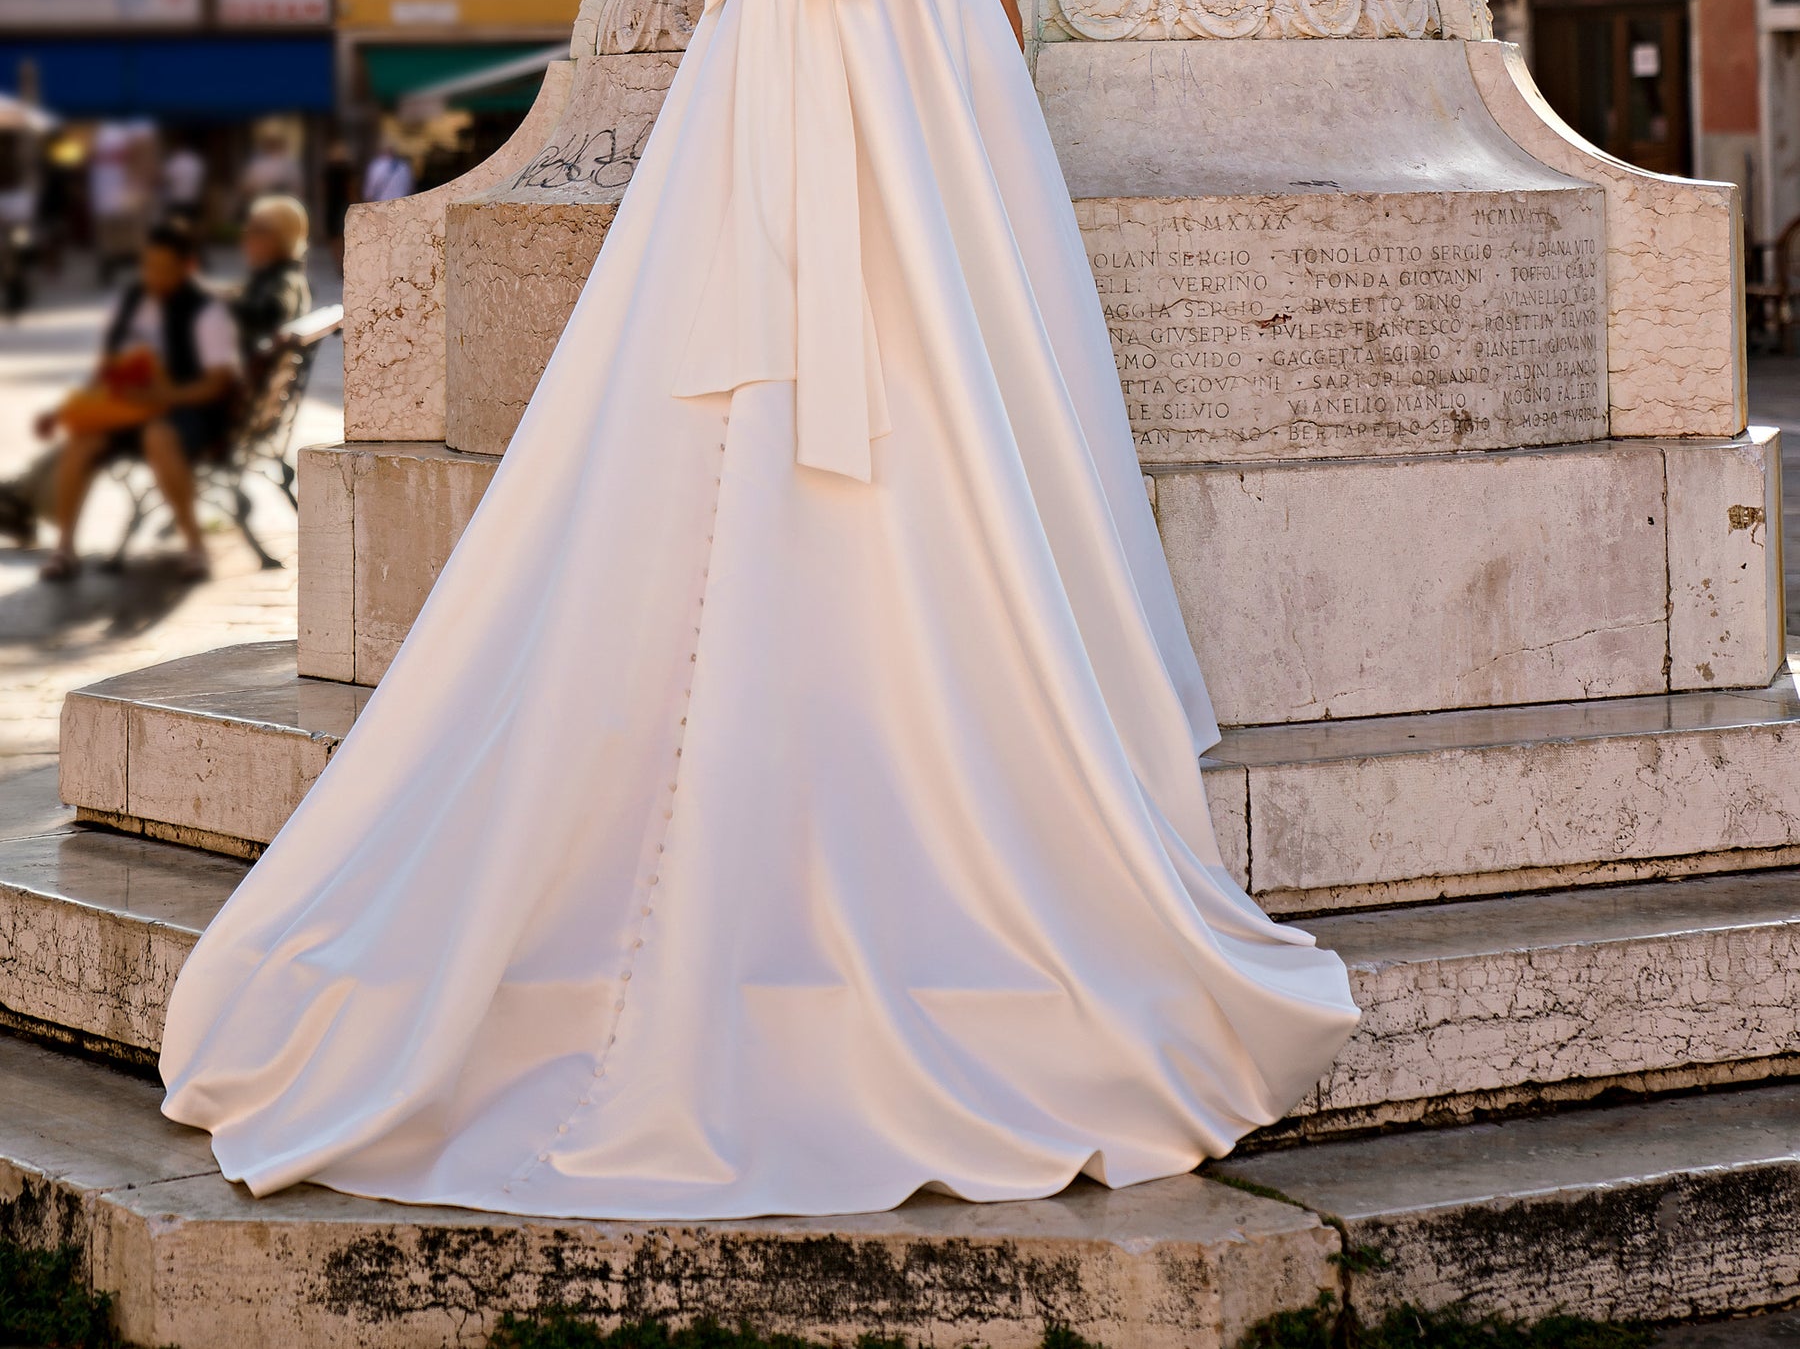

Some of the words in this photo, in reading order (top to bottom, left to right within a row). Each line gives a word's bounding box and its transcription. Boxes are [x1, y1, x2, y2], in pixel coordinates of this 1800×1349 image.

[1167, 250, 1251, 268] SERGIO
[1291, 246, 1423, 265] TONOLOTTO
[1431, 243, 1492, 261] SERGIO
[1575, 238, 1595, 255] VITO
[1316, 271, 1390, 289] FONDA
[1399, 267, 1482, 287] GIOVANNI
[1184, 300, 1264, 319] SERGIO
[1311, 296, 1402, 315] BVSETTO
[1415, 293, 1462, 311] DINO
[1505, 288, 1568, 307] VIANELLO
[1151, 324, 1251, 344] GIVSEPPE
[1353, 317, 1462, 339] FRANCESCO
[1170, 351, 1242, 369] GVIDO
[1273, 348, 1376, 367] GAGGETTA
[1476, 338, 1541, 358] PIANETTI
[1548, 333, 1597, 354] GIOVANNI
[1411, 366, 1491, 386] ORLANDO
[1505, 362, 1550, 381] TADINI
[1287, 397, 1387, 415] VIANELLO
[1396, 393, 1467, 411] MANLIO
[1503, 387, 1551, 406] MOGNO
